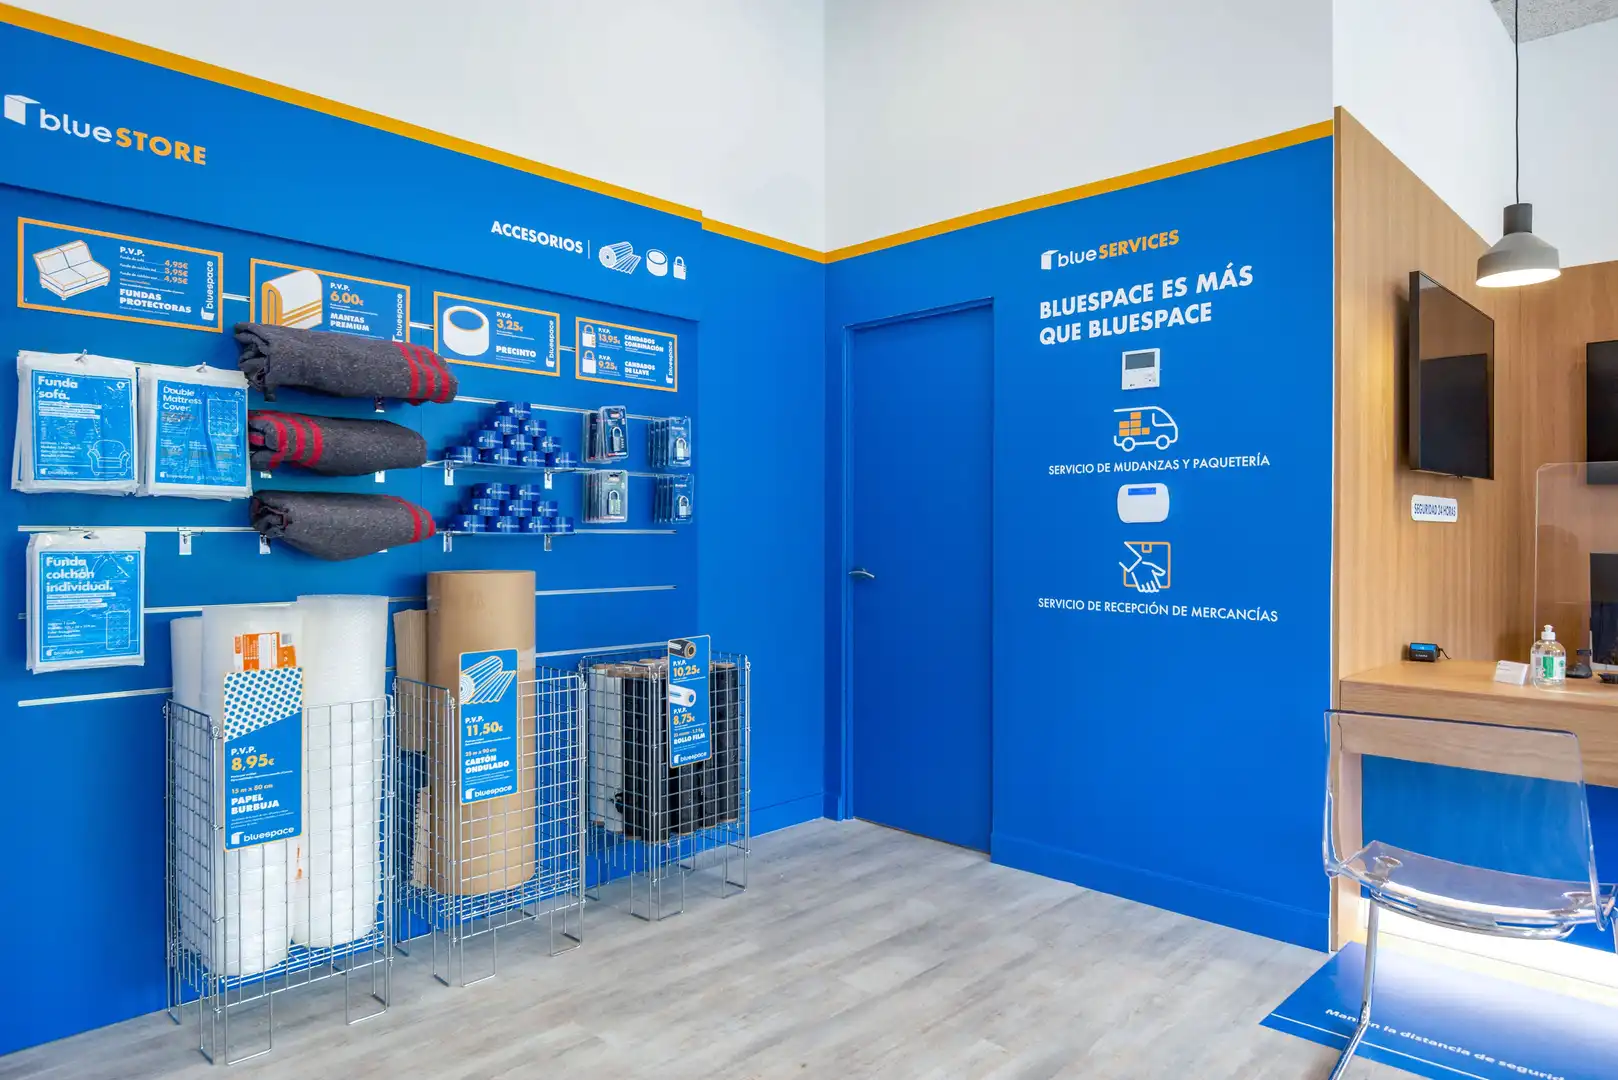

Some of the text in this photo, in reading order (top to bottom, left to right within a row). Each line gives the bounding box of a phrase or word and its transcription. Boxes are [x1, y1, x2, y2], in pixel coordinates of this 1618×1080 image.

[490, 220, 584, 254] ACCESORIOS
[119, 246, 145, 257] P.V.P.
[205, 260, 215, 309] bluespace
[330, 282, 351, 291] P.V.P.
[1039, 261, 1254, 320] BLUESPACE ES MÁS
[119, 288, 162, 301] FUNDAS
[330, 290, 364, 306] 6,00€
[119, 297, 192, 313] PROTECTORAS
[330, 312, 365, 324] MANTAS
[396, 293, 404, 336] bluespace
[330, 320, 370, 332] PREMIUM
[1039, 302, 1212, 345] QUE BLUESPACE
[624, 334, 656, 344] CANDADOS
[495, 345, 537, 358] PRECINTO
[624, 340, 664, 352] COMBINACIÓN
[624, 361, 656, 371] CANDADOS
[633, 368, 650, 376] LLAVE
[38, 375, 78, 389] Funda
[163, 386, 195, 396] Double
[162, 394, 202, 405] Mattress
[1048, 452, 1271, 475] SERVICIO DE MUDANZAS Y PAQUETERÍA
[1413, 503, 1437, 515] SEGURIDAD
[1443, 505, 1456, 516] HORAS
[45, 556, 87, 567] Funda
[45, 568, 95, 579] colchón
[1038, 597, 1279, 622] SERVICIO DE RECEPCIÓN DE MERCANCÍAS
[464, 715, 485, 724] P.V.P.
[466, 721, 504, 737] 11,50€
[673, 735, 692, 744] ROLLO
[692, 732, 706, 741] FILM
[230, 746, 256, 756] P.V.P.
[231, 753, 275, 771] 8,95€
[464, 754, 497, 766] CARTÓN
[464, 760, 510, 774] ONDULADO
[474, 785, 513, 798] bluespace
[230, 793, 264, 805] PAPEL
[230, 800, 280, 815] BURBUJA
[243, 827, 295, 842] bluespace
[1383, 1025, 1397, 1034] la
[1399, 1031, 1471, 1057] distancia
[1473, 1053, 1496, 1063] de
